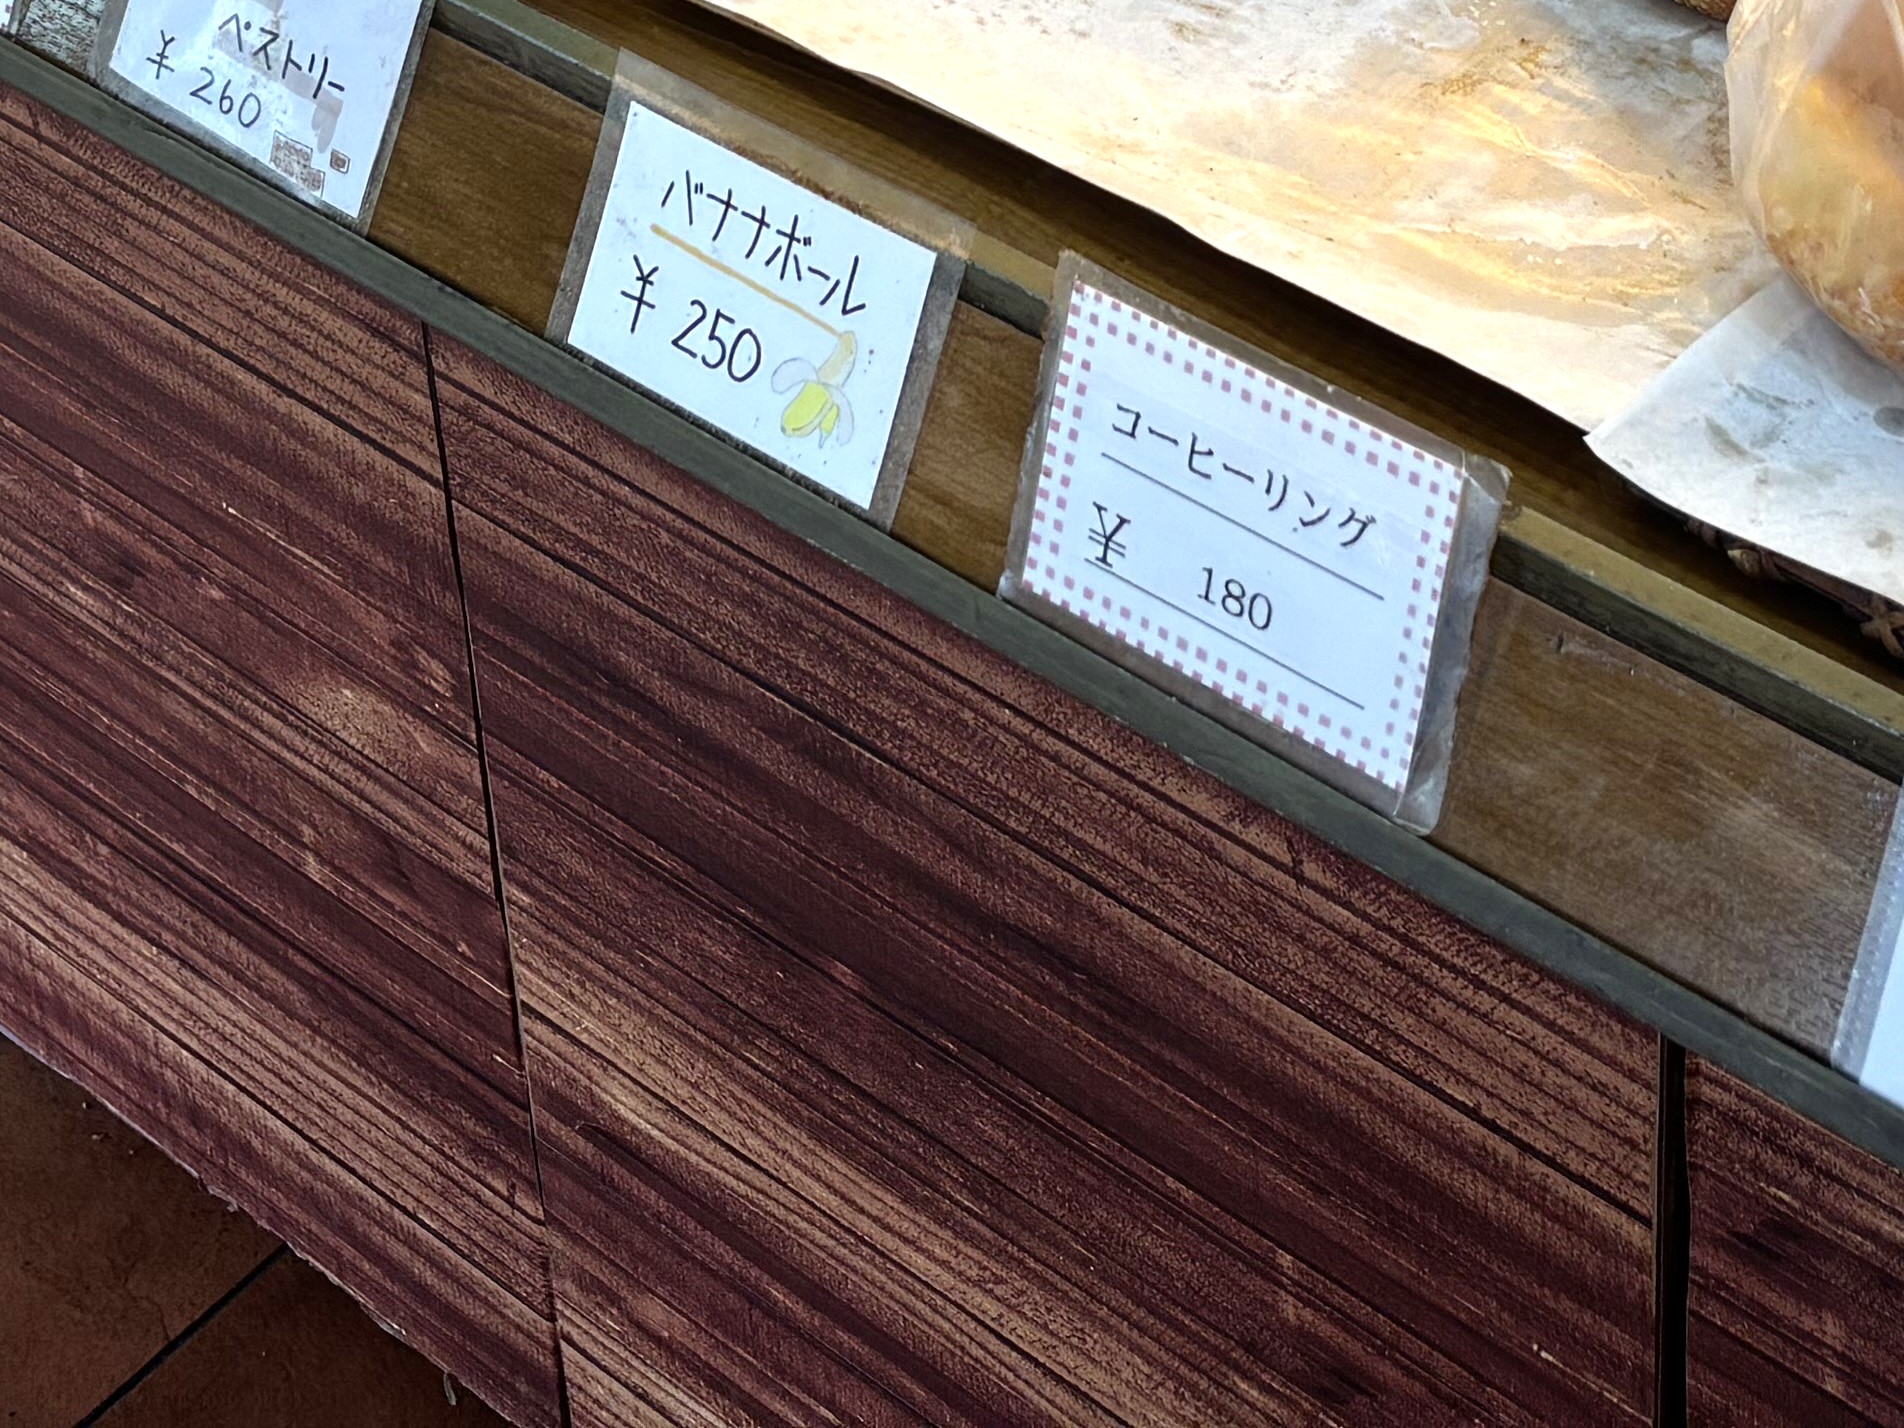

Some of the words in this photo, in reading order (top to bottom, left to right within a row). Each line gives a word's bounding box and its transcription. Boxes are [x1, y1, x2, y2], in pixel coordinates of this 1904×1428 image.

[189, 67, 262, 128] 260
[218, 13, 345, 99] ペストリー
[661, 169, 866, 315] バナナボール
[671, 299, 763, 383] 250
[1112, 403, 1377, 549] コーヒーリング
[1196, 566, 1273, 632] 180
